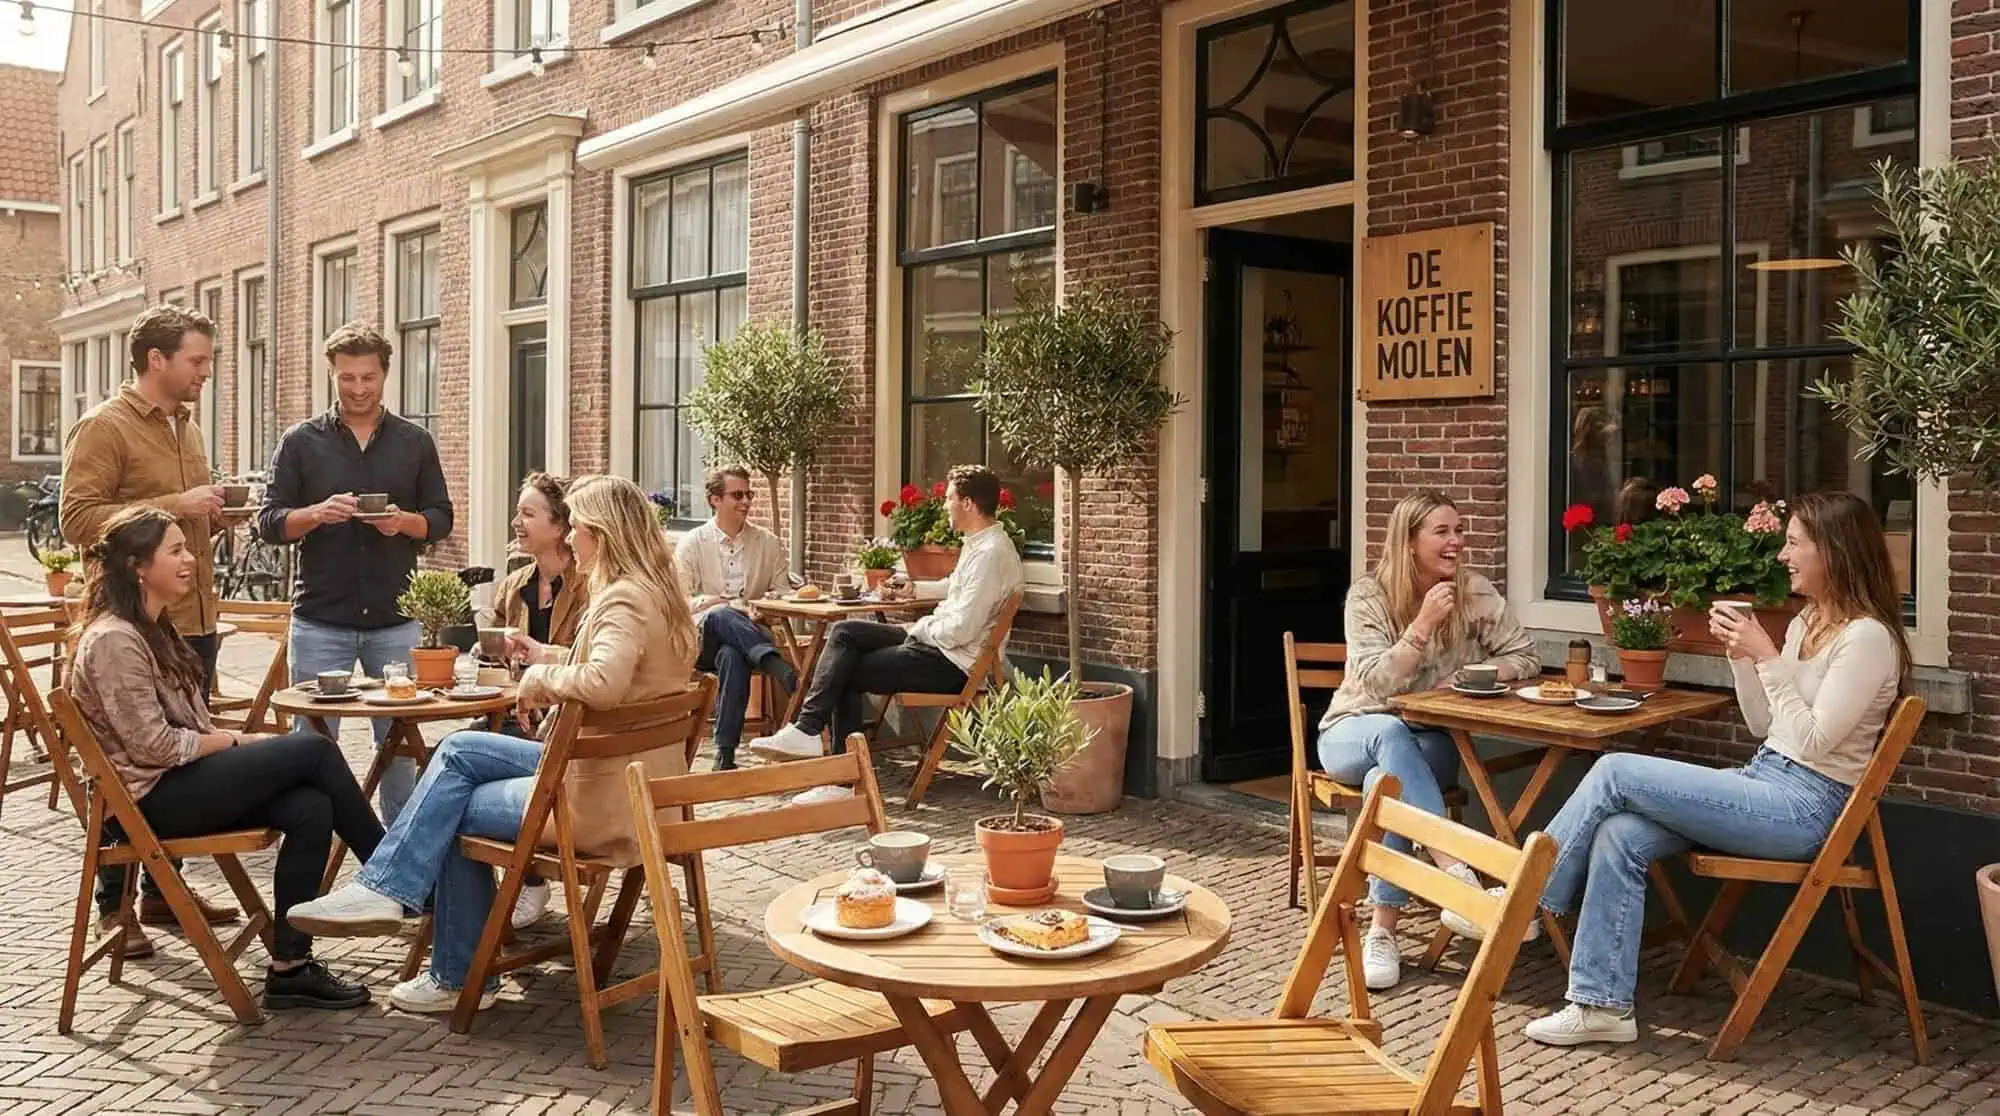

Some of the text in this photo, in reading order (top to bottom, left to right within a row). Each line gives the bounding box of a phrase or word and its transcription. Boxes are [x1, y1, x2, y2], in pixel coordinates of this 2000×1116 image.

[1407, 249, 1442, 290] DE
[1377, 291, 1473, 337] KOFFIE
[1377, 337, 1472, 380] MOLEN
